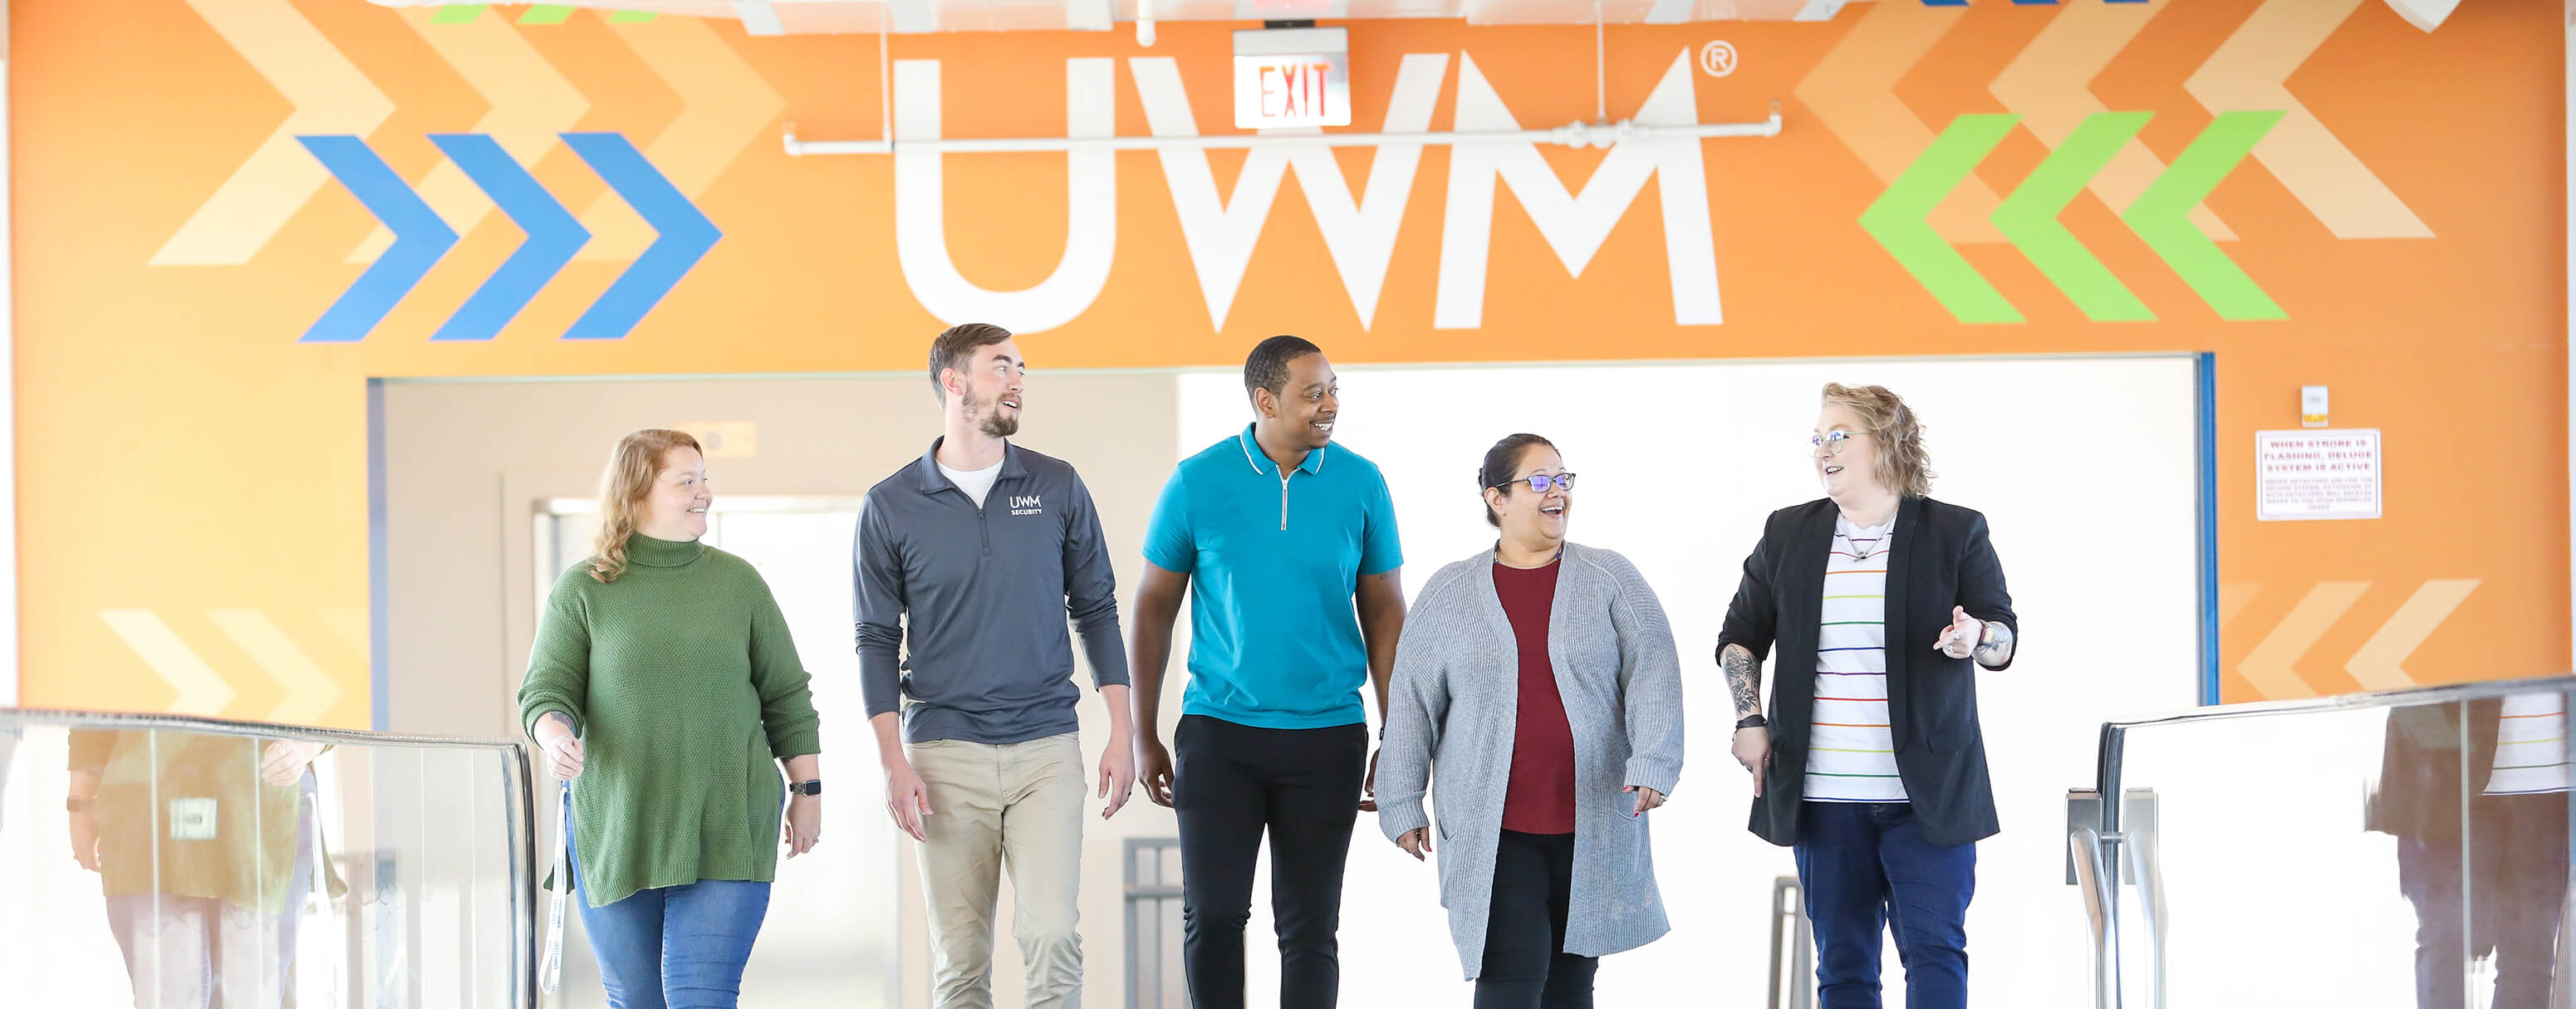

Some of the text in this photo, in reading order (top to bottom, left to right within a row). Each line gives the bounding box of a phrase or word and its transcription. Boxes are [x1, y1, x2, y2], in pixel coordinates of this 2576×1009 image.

[1259, 64, 1330, 117] EXIT
[2309, 439, 2352, 448] STROBE
[2356, 438, 2367, 447] IS
[2328, 451, 2372, 459] DELUGE
[2267, 464, 2312, 473] SYSTEM
[1009, 495, 1042, 508] UWM
